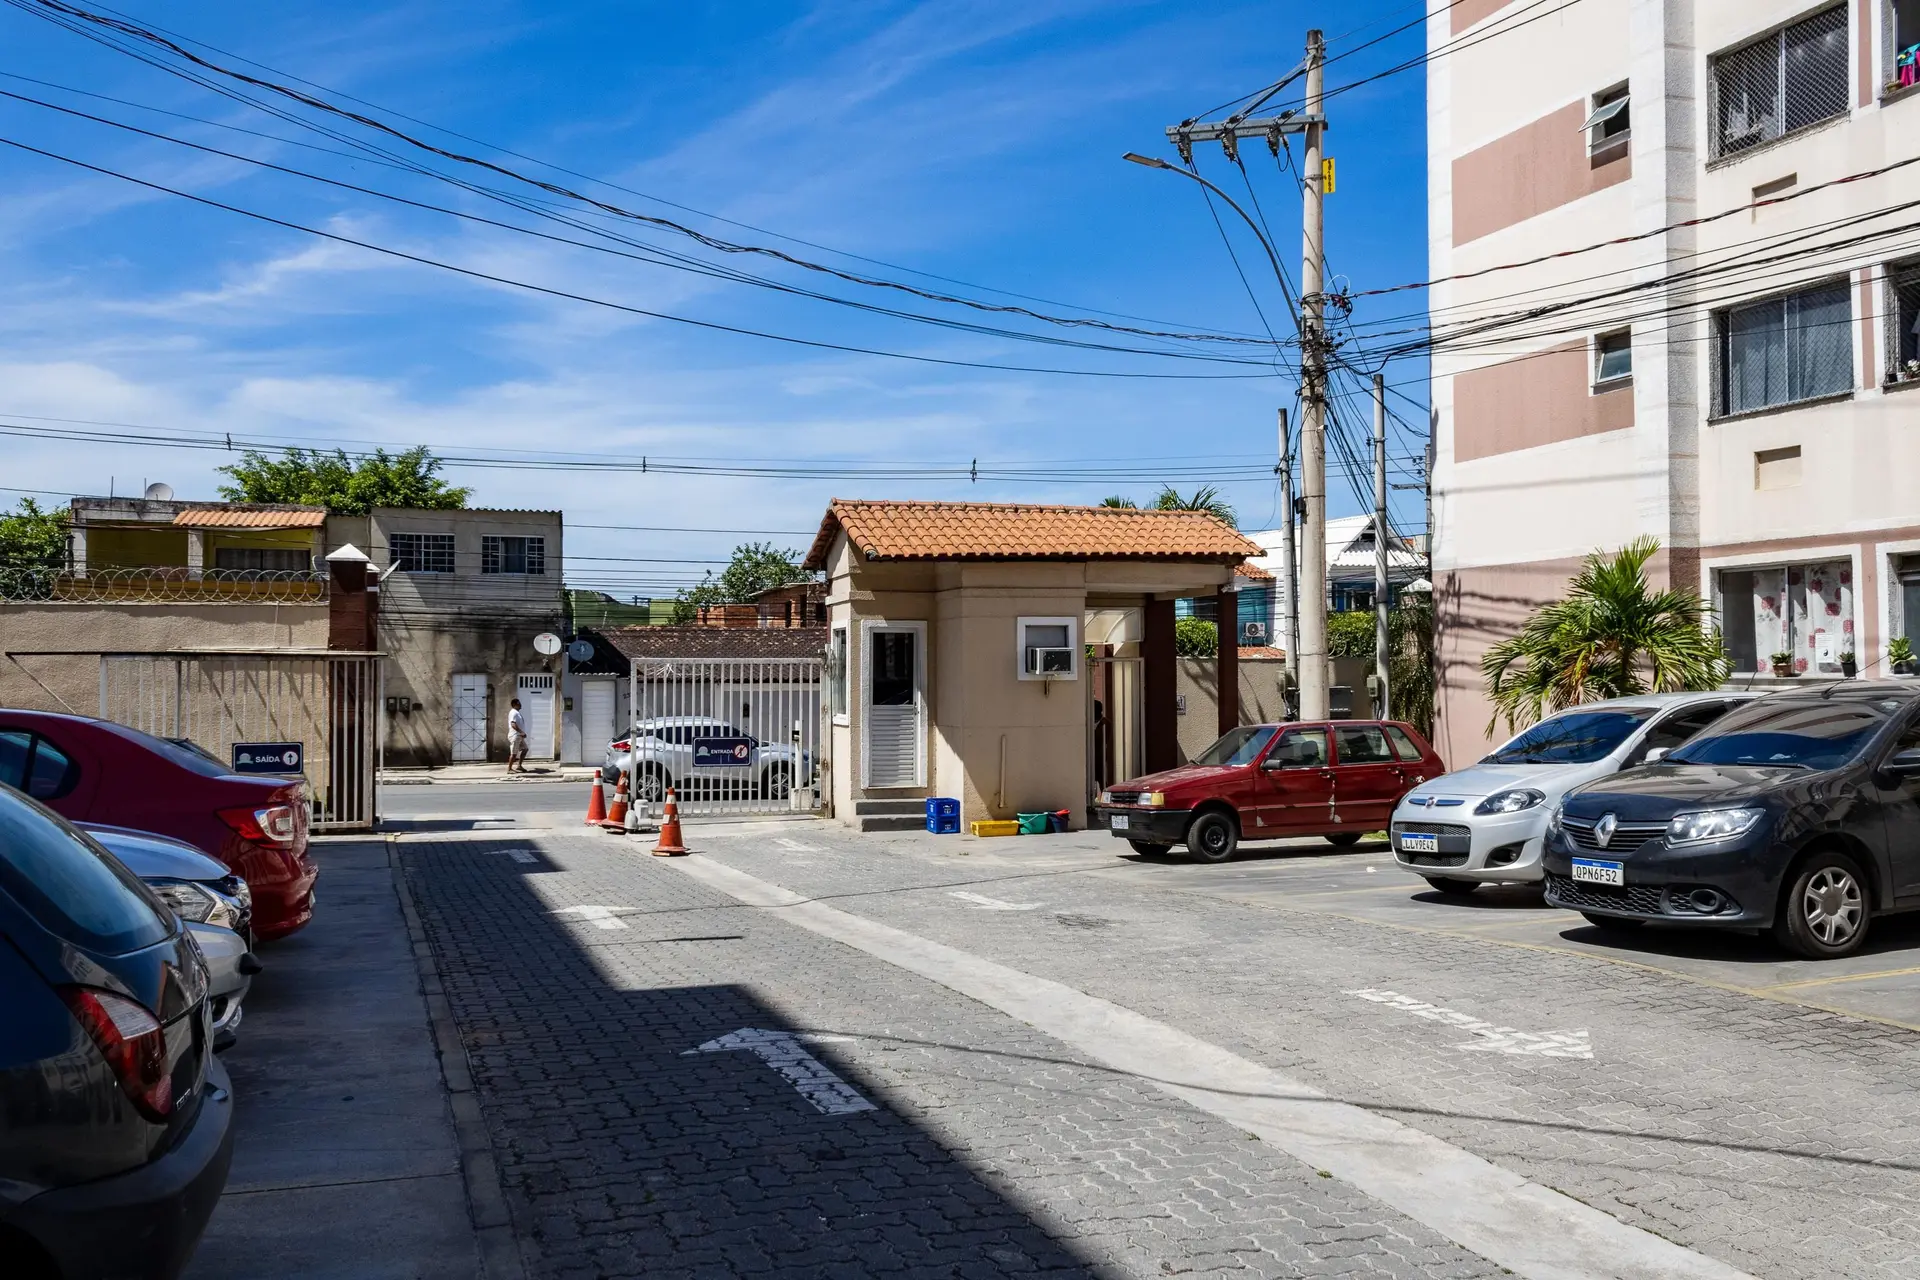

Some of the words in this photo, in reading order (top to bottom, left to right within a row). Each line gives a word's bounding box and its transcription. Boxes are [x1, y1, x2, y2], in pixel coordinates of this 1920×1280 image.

[255, 754, 280, 763] SAÍDA
[1405, 839, 1434, 850] LLY9E42
[1576, 866, 1617, 883] QPN6F52
